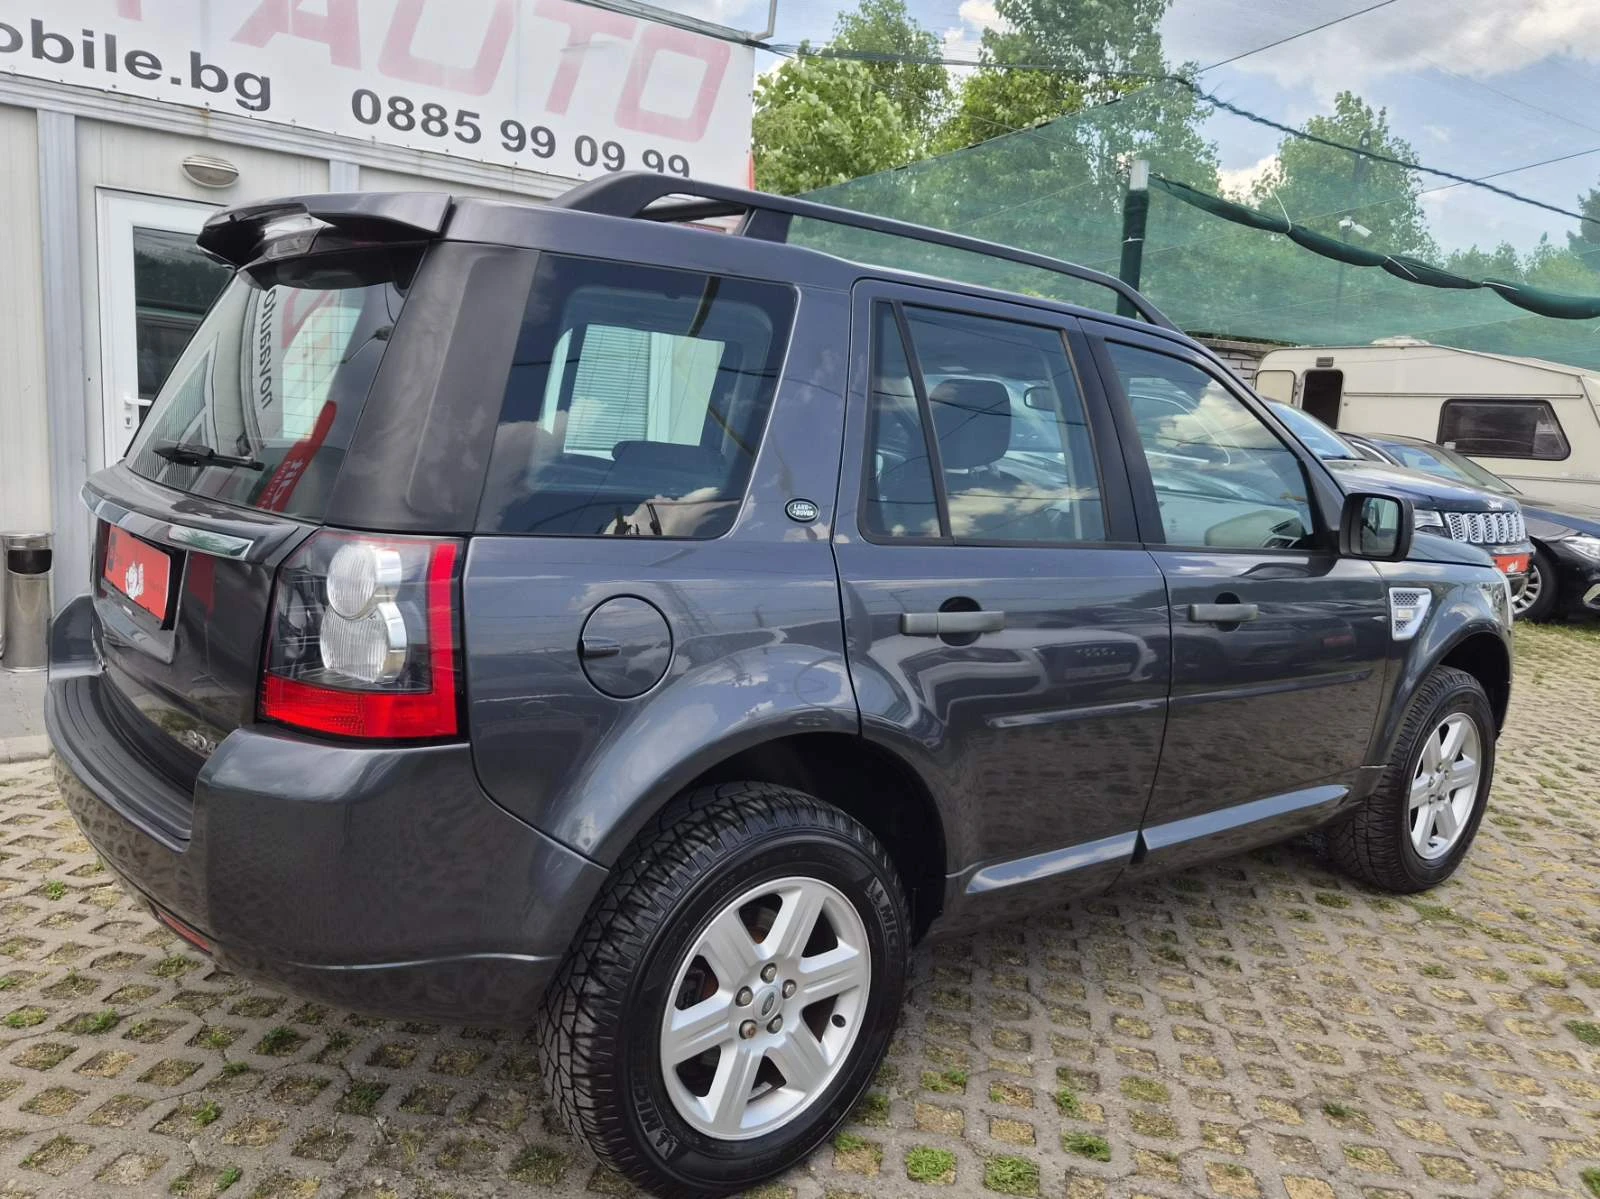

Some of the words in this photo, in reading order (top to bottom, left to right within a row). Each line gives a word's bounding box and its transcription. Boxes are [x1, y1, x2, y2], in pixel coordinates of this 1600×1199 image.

[230, 0, 732, 143] AUTO
[351, 88, 482, 144] 0885
[500, 119, 557, 160] 99
[574, 134, 626, 173] 09
[642, 149, 690, 179] 99
